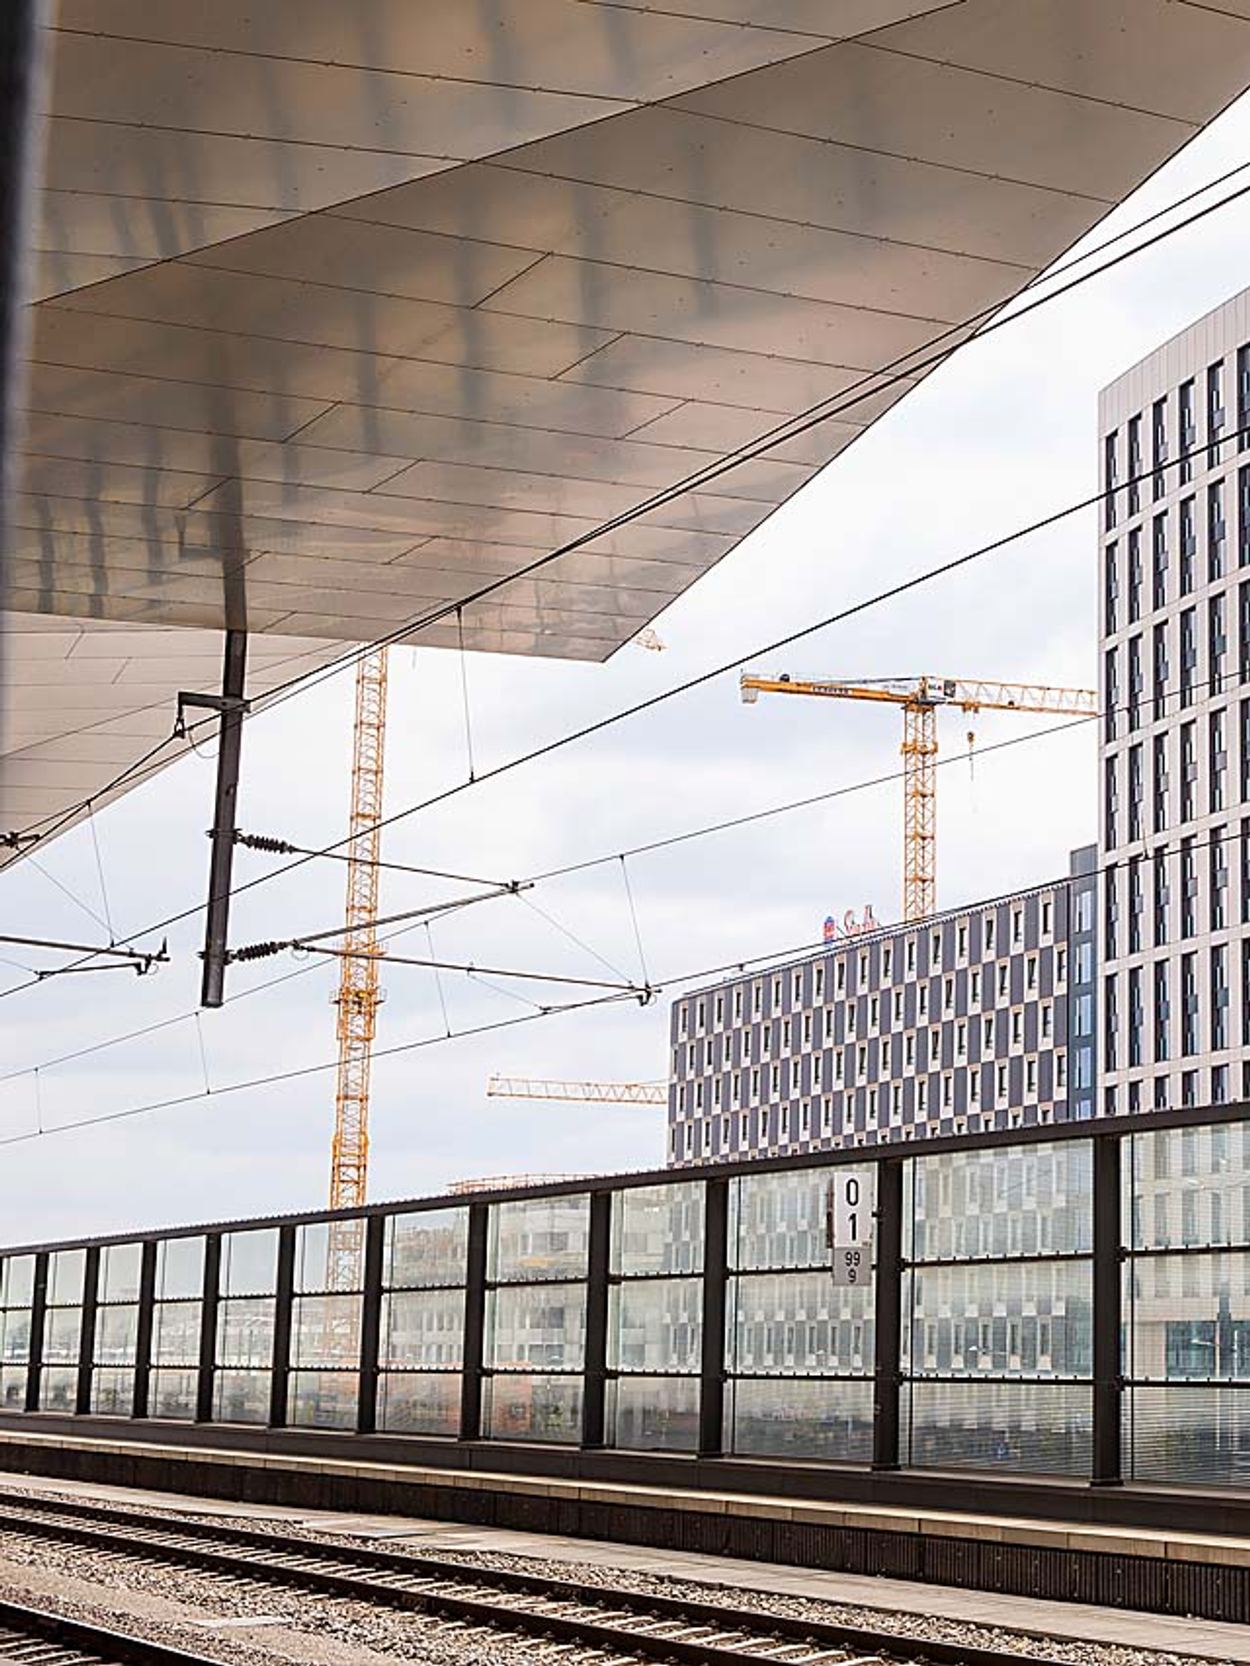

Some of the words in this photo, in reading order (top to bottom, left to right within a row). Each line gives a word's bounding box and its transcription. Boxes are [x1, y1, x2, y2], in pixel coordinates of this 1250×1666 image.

[845, 1178, 859, 1206] 0
[848, 1212, 857, 1241] 1
[845, 1251, 861, 1267] 99
[847, 1268, 857, 1284] 9
